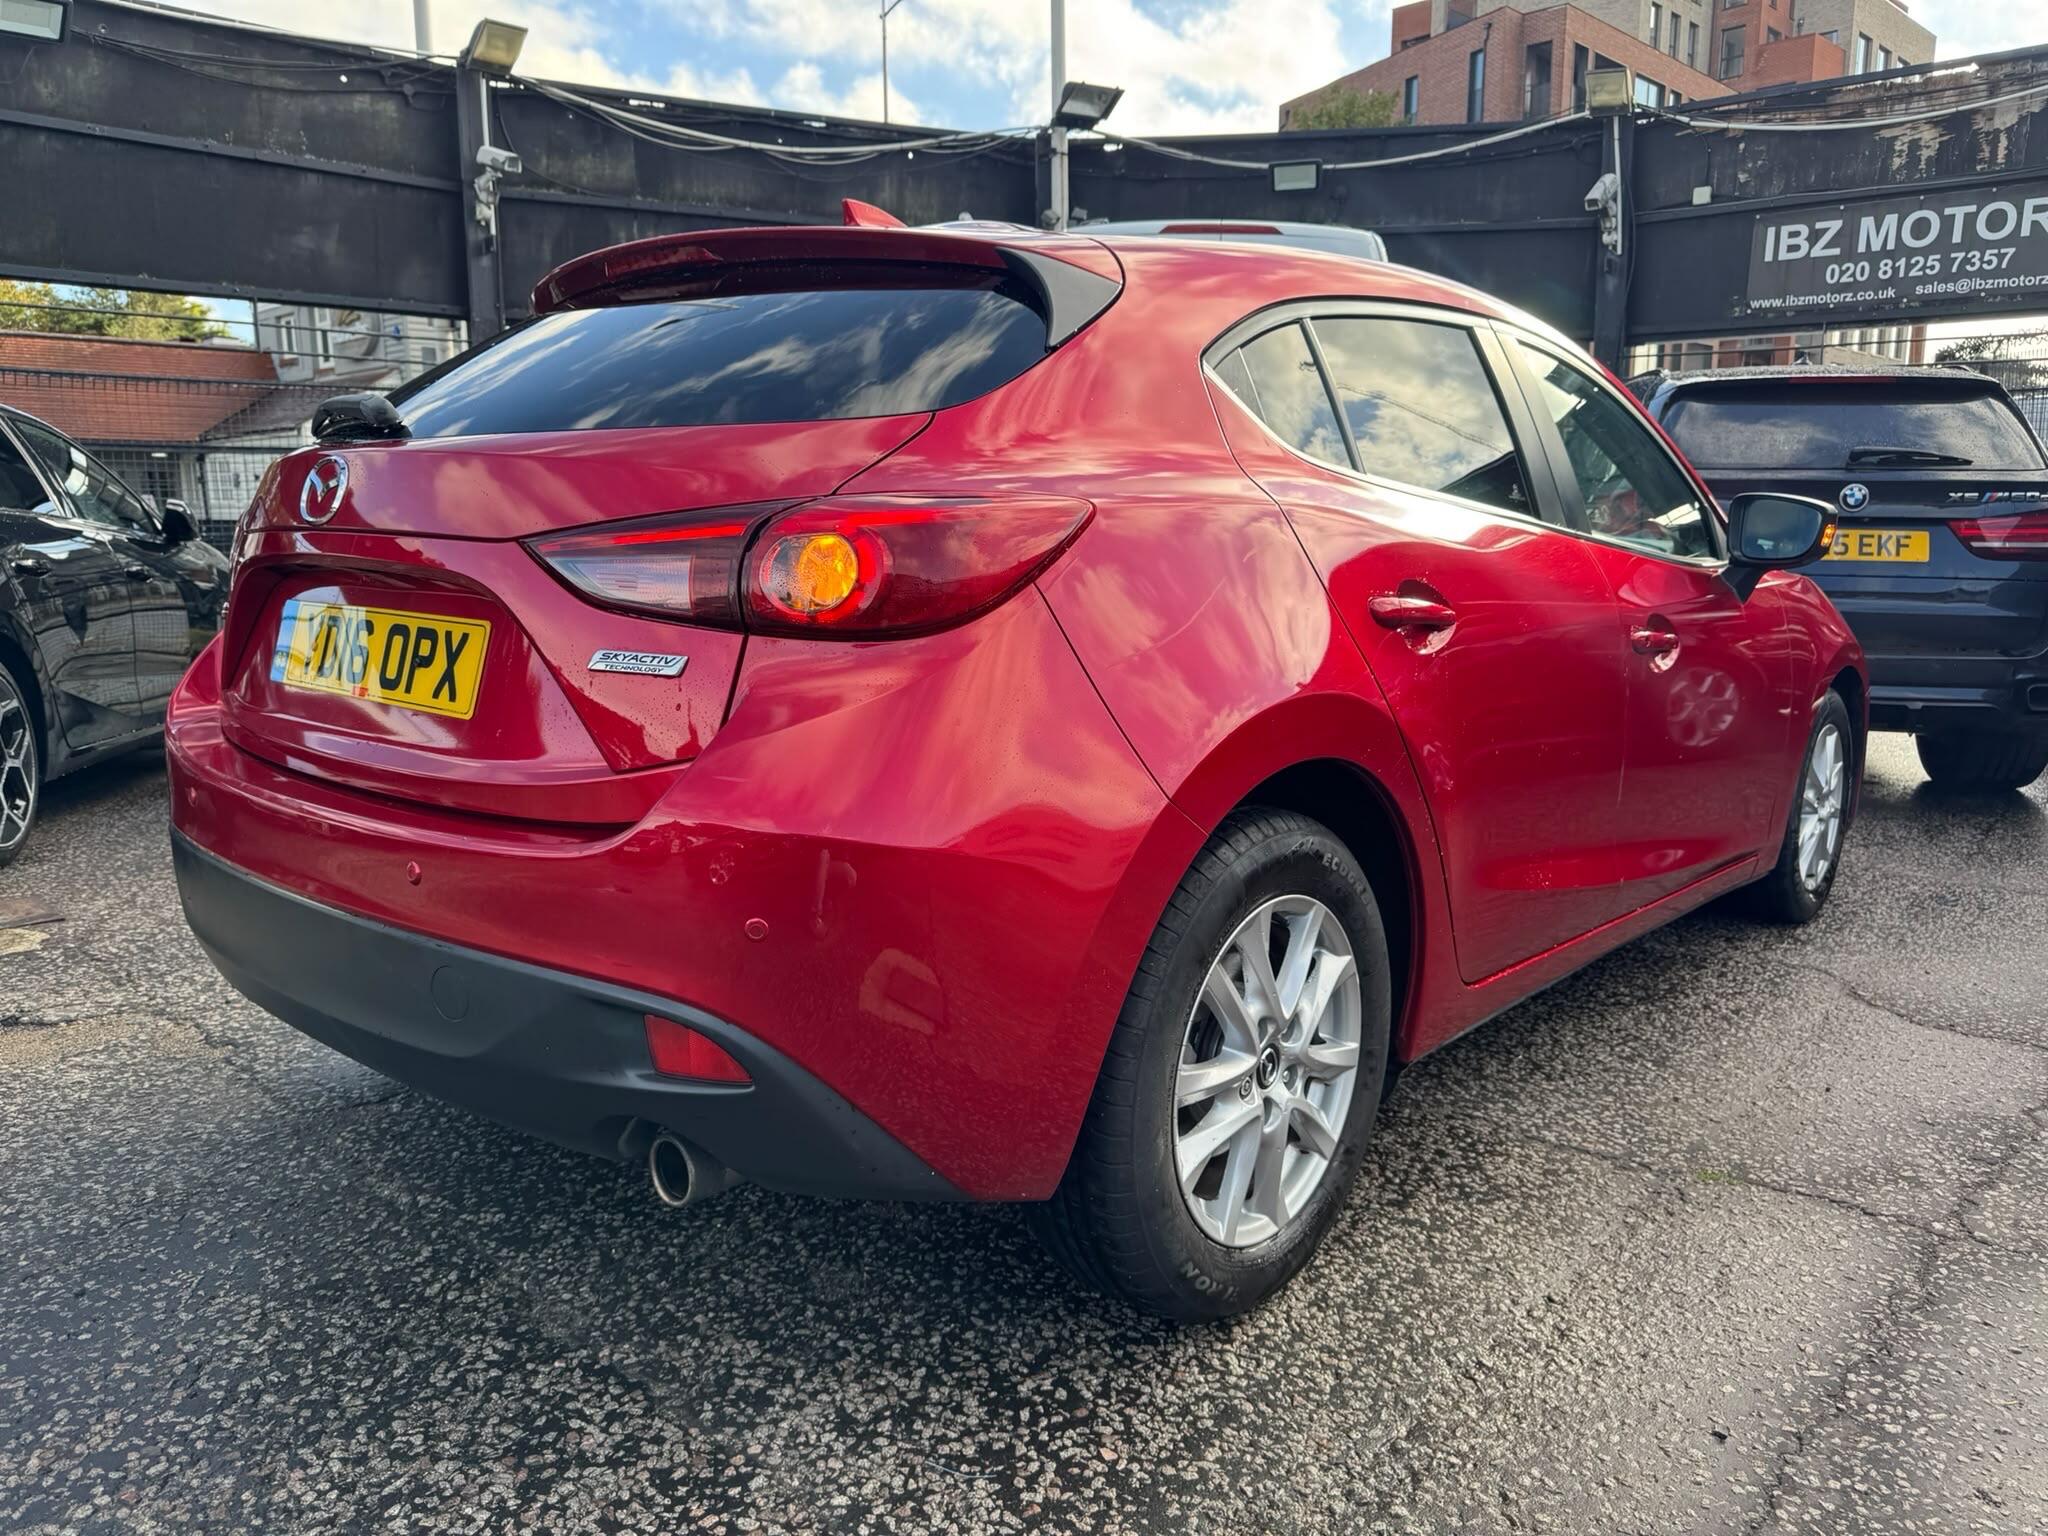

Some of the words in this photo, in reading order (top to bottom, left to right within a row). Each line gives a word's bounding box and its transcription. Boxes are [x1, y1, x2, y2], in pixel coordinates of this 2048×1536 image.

[1763, 219, 1843, 263] IBZ
[1825, 261, 1870, 285] 020
[1878, 254, 1942, 280] 8125
[1950, 247, 2017, 273] 7357
[1750, 286, 1897, 309] www.ibzmotorz.co.uk
[1858, 534, 1912, 557] EKF
[378, 623, 470, 703] OPX
[599, 652, 677, 665] SKYACTIV
[604, 663, 664, 674] TECHNOLOGY
